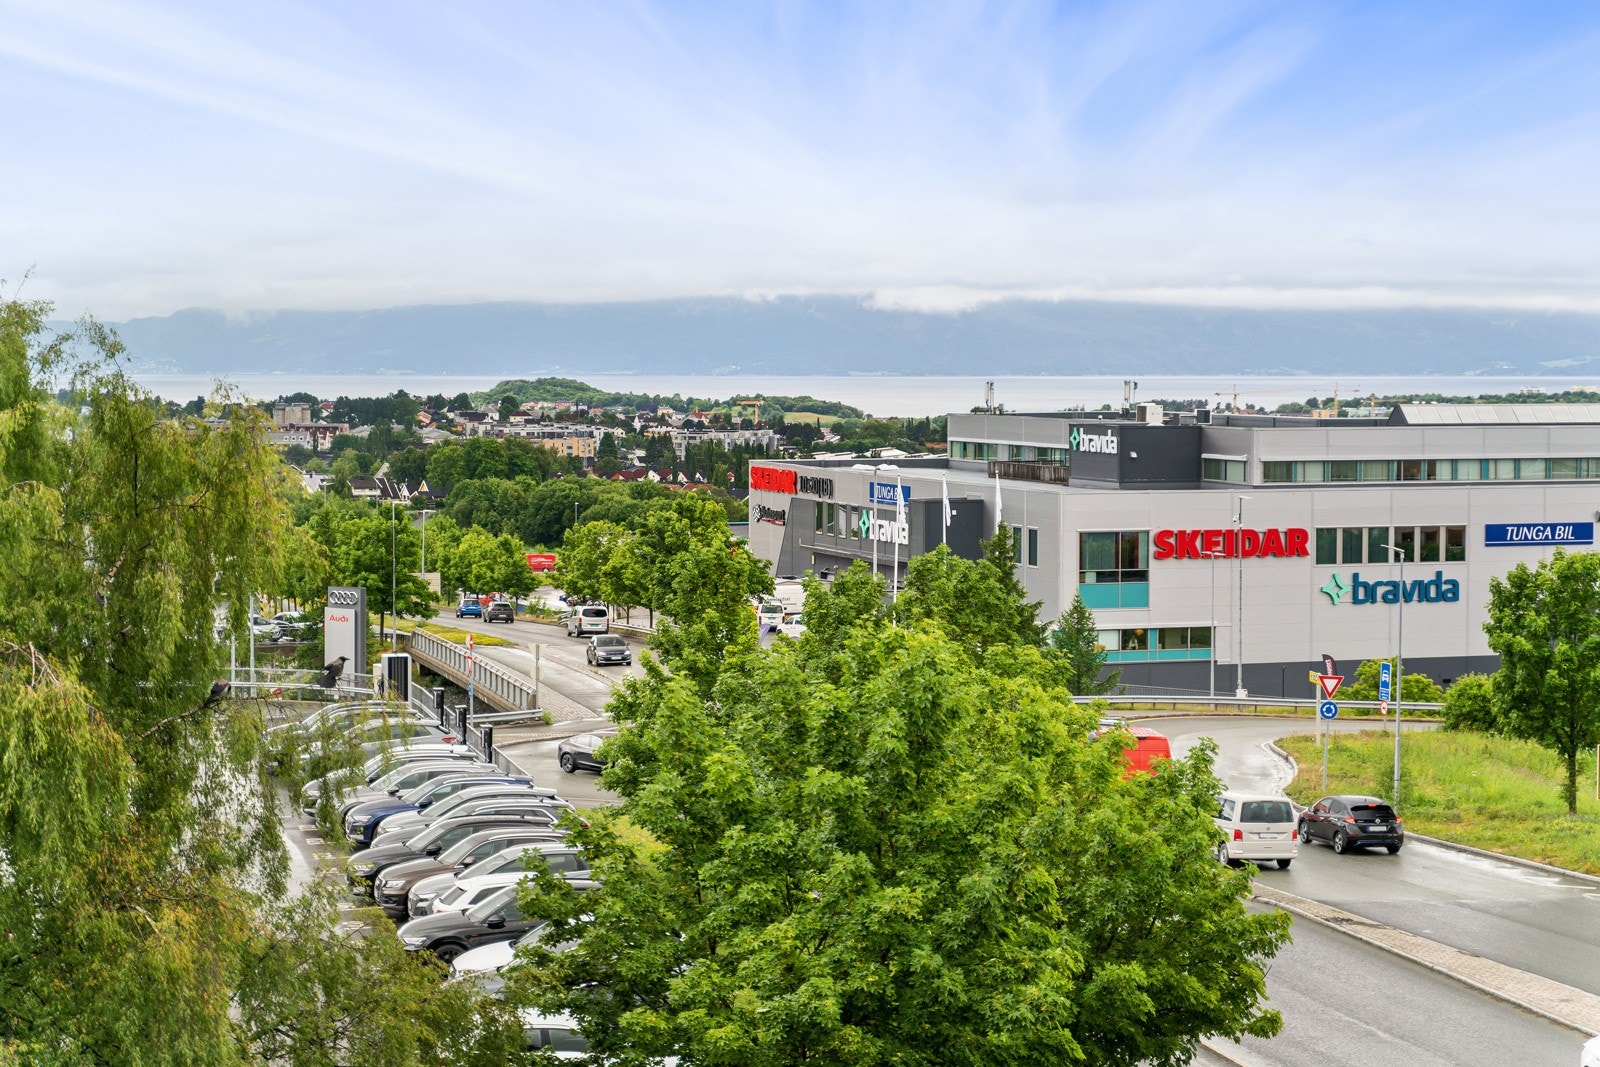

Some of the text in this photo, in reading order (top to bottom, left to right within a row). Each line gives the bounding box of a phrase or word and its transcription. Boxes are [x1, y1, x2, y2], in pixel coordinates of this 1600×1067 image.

[1079, 427, 1118, 454] bravida
[750, 466, 797, 495] SKEIDAR
[1154, 528, 1310, 560] SKEIDAR
[1506, 525, 1575, 541] TUNGA BIL
[1352, 570, 1460, 605] bravida
[329, 614, 349, 623] Audi
